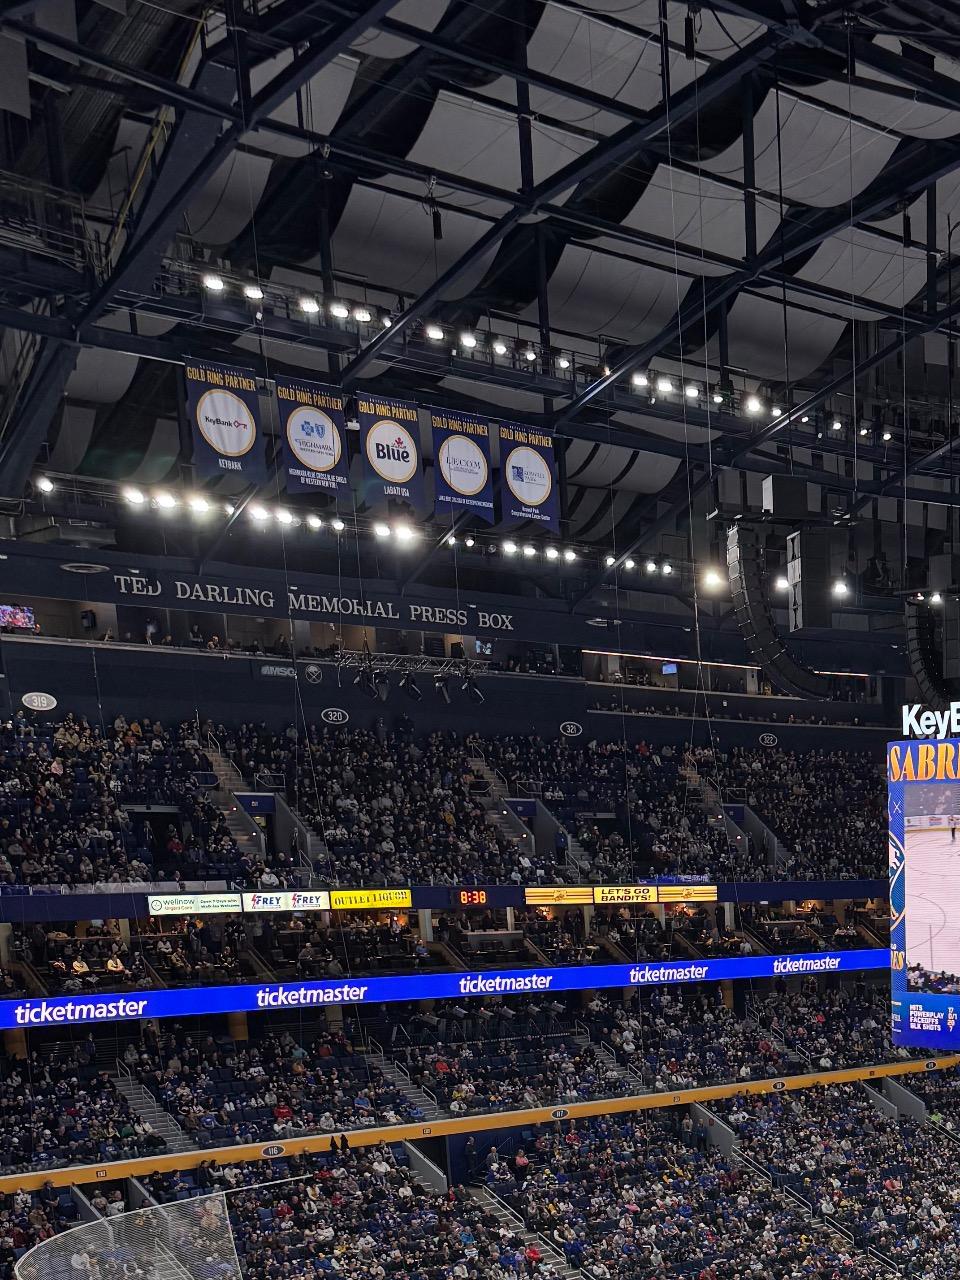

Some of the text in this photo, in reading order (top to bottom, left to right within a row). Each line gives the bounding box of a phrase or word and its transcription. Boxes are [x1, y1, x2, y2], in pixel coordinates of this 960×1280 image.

[187, 367, 205, 381] GOLD
[207, 373, 224, 385] RING
[225, 376, 256, 391] PARTNER
[278, 386, 294, 400] GOLD
[313, 394, 342, 411] PARTNER
[359, 401, 418, 421] GOLD RING PARTNER
[205, 416, 233, 427] KeyBank
[432, 415, 447, 429] GOLD
[463, 422, 488, 437] PARTNER
[500, 428, 514, 439] GOLD
[528, 433, 552, 447] PARTNER
[376, 443, 410, 463] Blue
[218, 459, 242, 470] KEYBANK
[114, 575, 513, 631] TED DARLING MEMORIAL PRESS BOX
[32, 696, 47, 707] 319
[328, 711, 343, 721] 320
[163, 897, 195, 905] wellnow
[256, 896, 281, 905] FREY
[296, 895, 321, 904] FREY
[460, 890, 487, 904] 8:38
[629, 964, 709, 984] ticketmaster
[773, 955, 841, 974] ticketmaster
[459, 973, 553, 994] ticketmaster
[256, 984, 368, 1008] ticketmaster
[14, 998, 148, 1025] ticketmaster
[910, 1011, 944, 1019] POWERPLAY
[268, 1147, 278, 1155] 116
